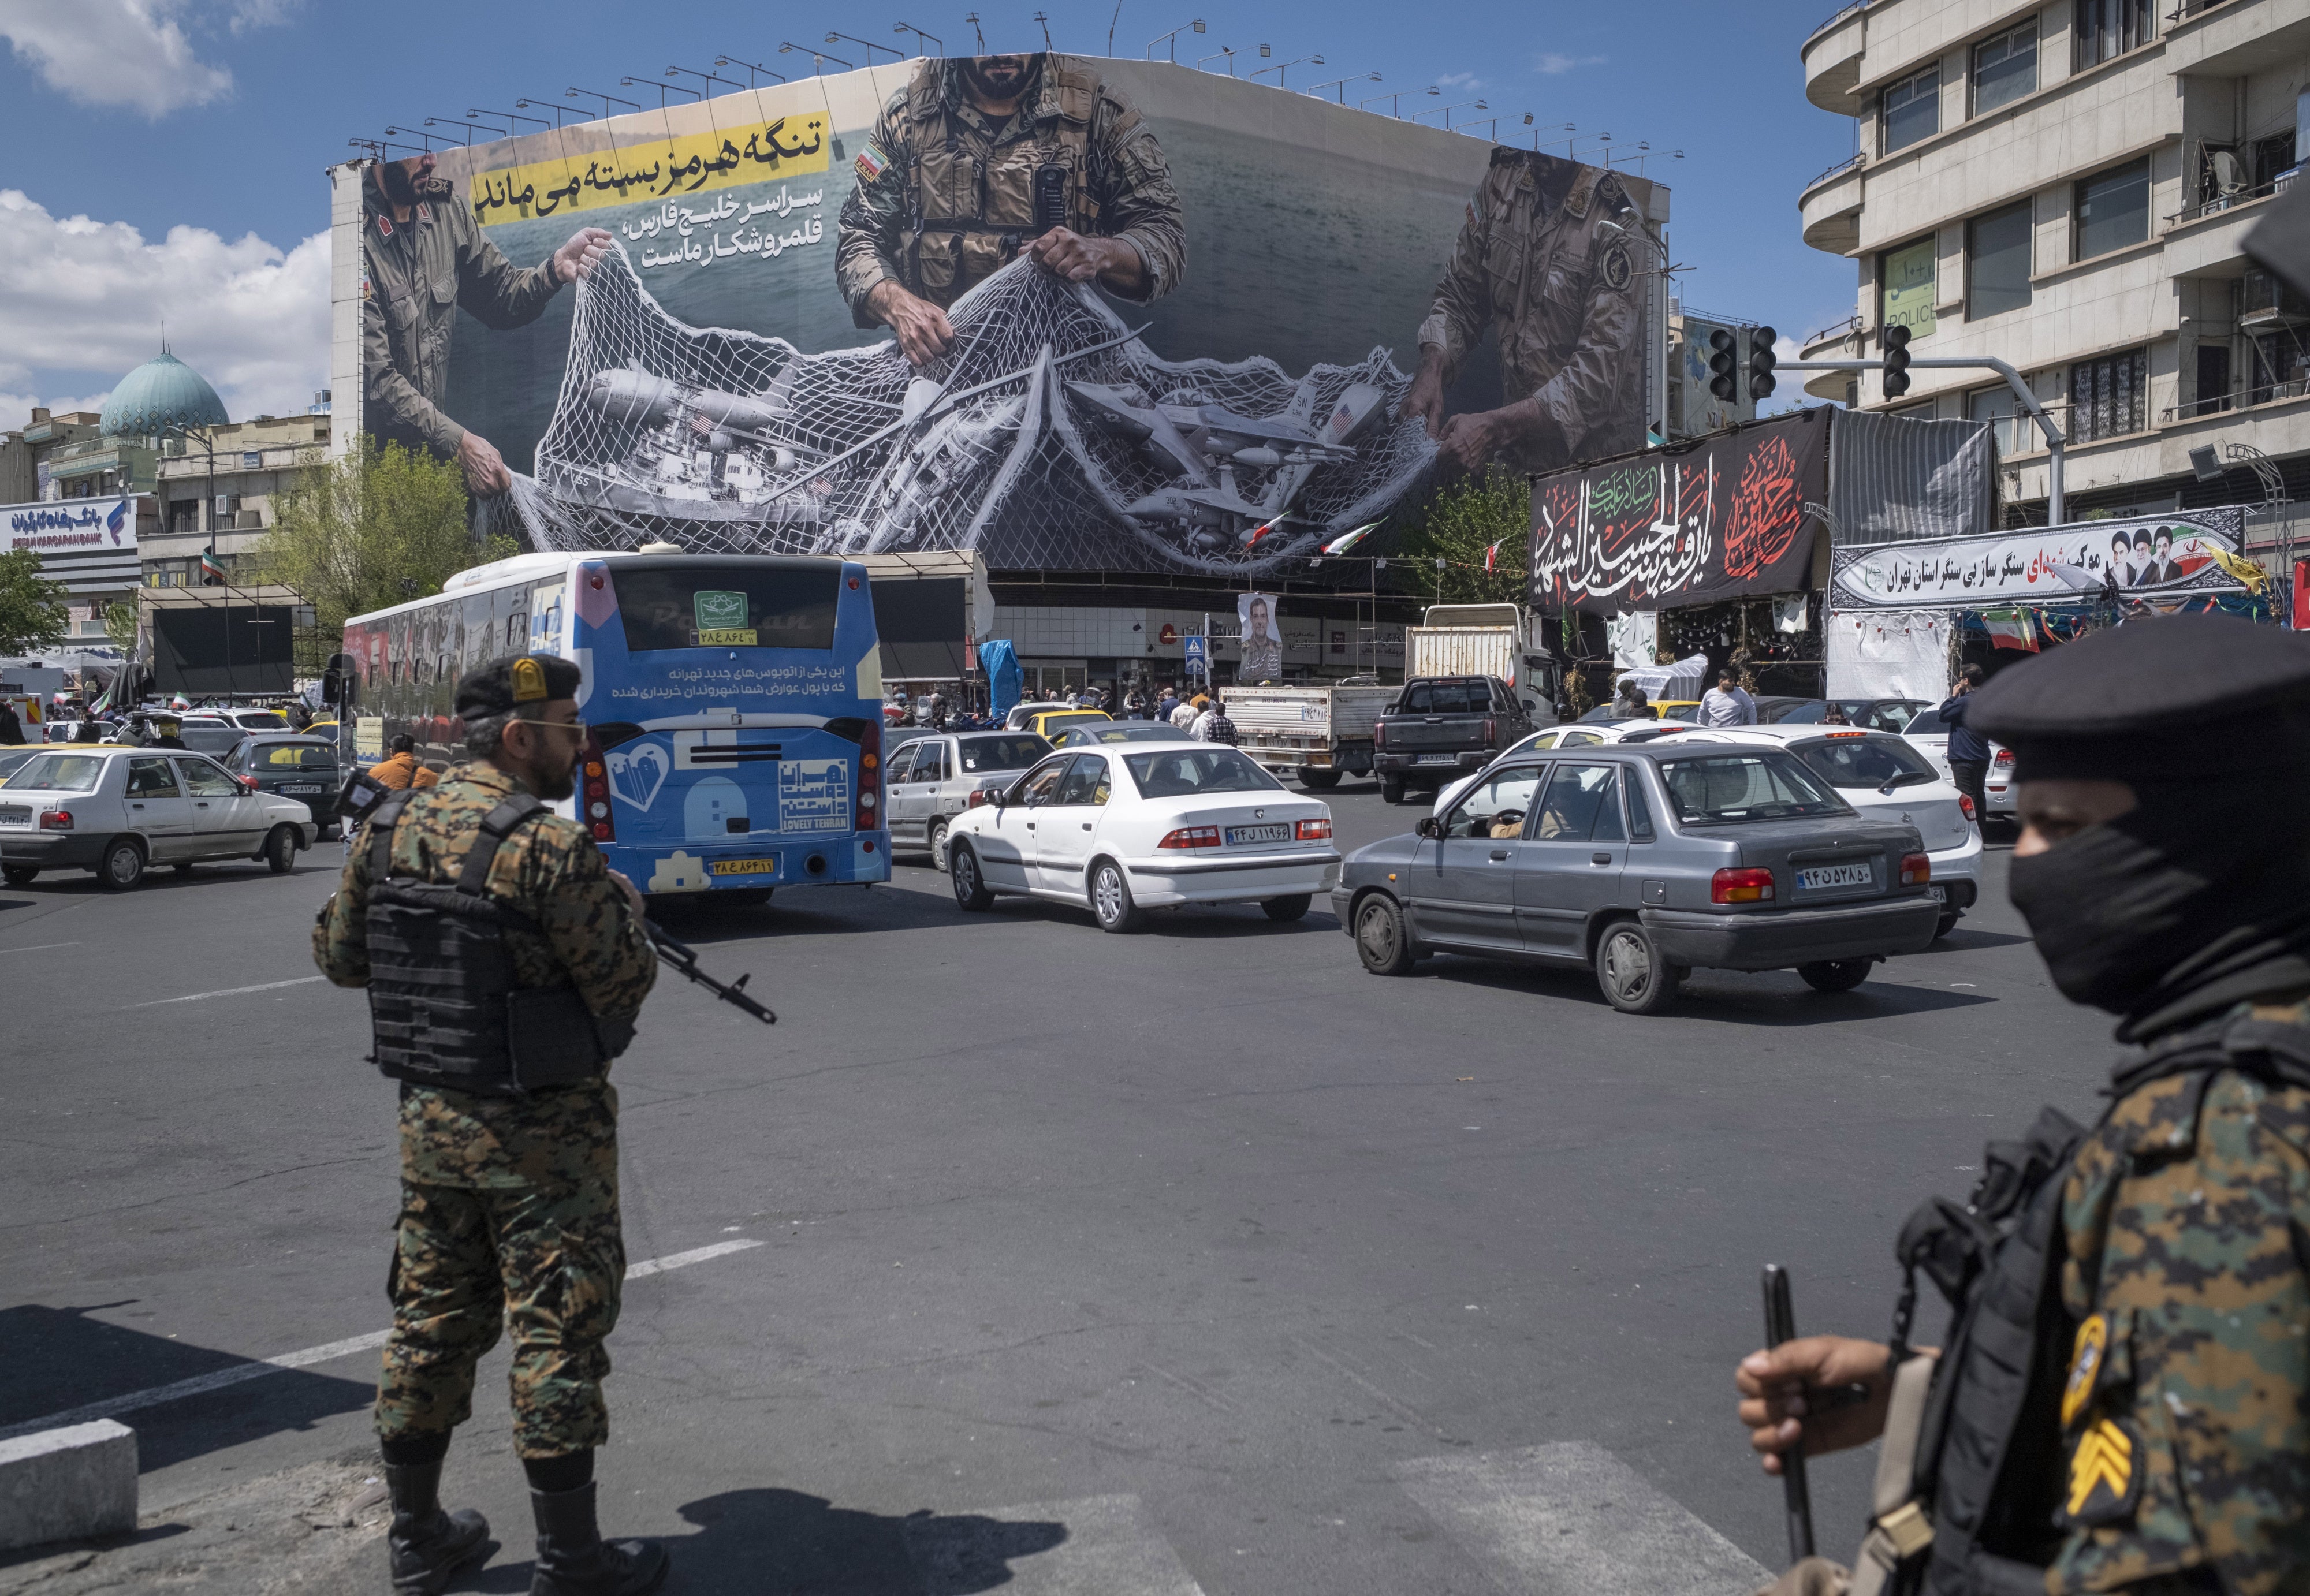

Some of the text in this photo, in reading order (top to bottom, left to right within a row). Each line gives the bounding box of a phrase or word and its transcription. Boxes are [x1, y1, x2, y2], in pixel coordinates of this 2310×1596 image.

[743, 117, 821, 163] تنگه
[584, 160, 660, 193] بسته
[657, 139, 739, 196] هرمز
[678, 193, 740, 236] خلیج
[738, 185, 823, 225] سراسر
[642, 212, 823, 268] قلمرو شکار ماست
[1889, 303, 1936, 327] POLICE
[1297, 396, 1307, 408] SW
[572, 473, 590, 486] USS
[1276, 480, 1285, 497] AJ
[1165, 497, 1177, 505] 302
[12, 510, 47, 535] کارگران
[73, 506, 102, 531] بانک
[80, 532, 102, 546] BANK
[1887, 561, 1912, 593] تهران
[1913, 557, 1938, 592] استان
[1939, 557, 1961, 590] سنگر
[1964, 561, 1977, 588] بی
[1999, 551, 2024, 586] سنگر
[669, 668, 702, 681] تهرانه
[704, 669, 731, 681] جدید
[796, 666, 806, 678] از
[807, 667, 827, 679] یکی
[829, 666, 845, 678] این
[612, 682, 845, 700] که با پول عوارض شما شهروندان خریداری شده
[783, 817, 847, 830] LOVELY TEHRAN
